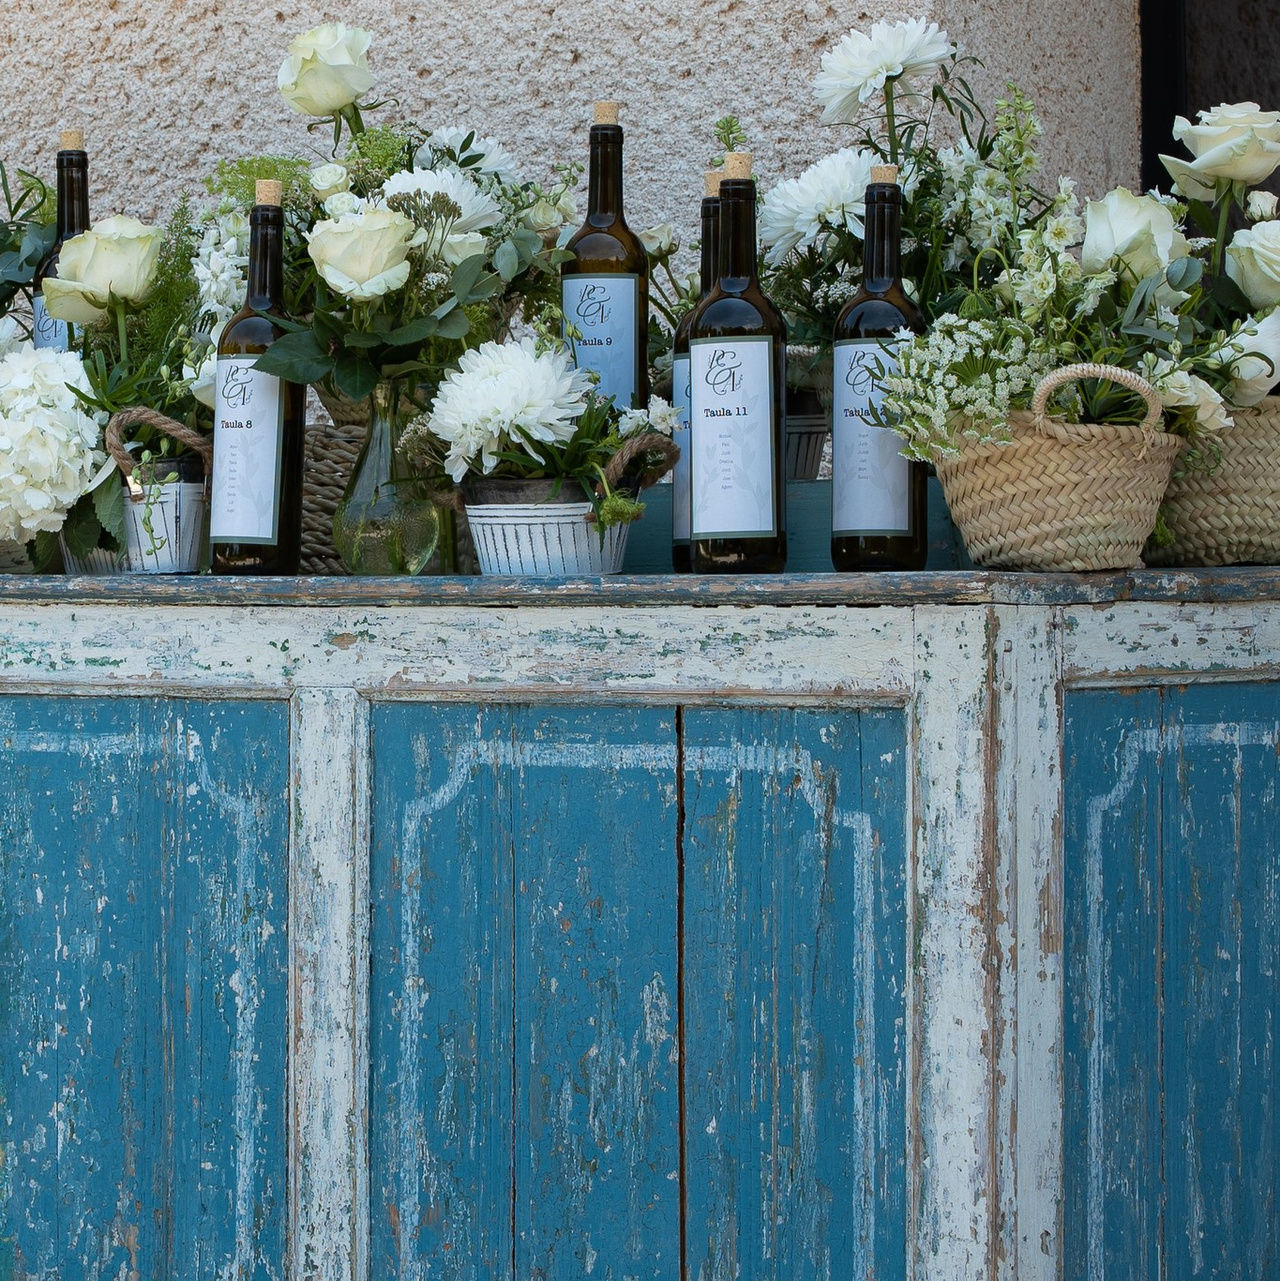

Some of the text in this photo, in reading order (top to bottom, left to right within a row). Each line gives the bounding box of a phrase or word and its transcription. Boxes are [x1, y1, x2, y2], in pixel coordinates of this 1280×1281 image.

[606, 337, 613, 346] 9
[704, 407, 748, 417] Taula 11
[844, 407, 870, 417] Taula
[221, 419, 253, 429] Taula 8
